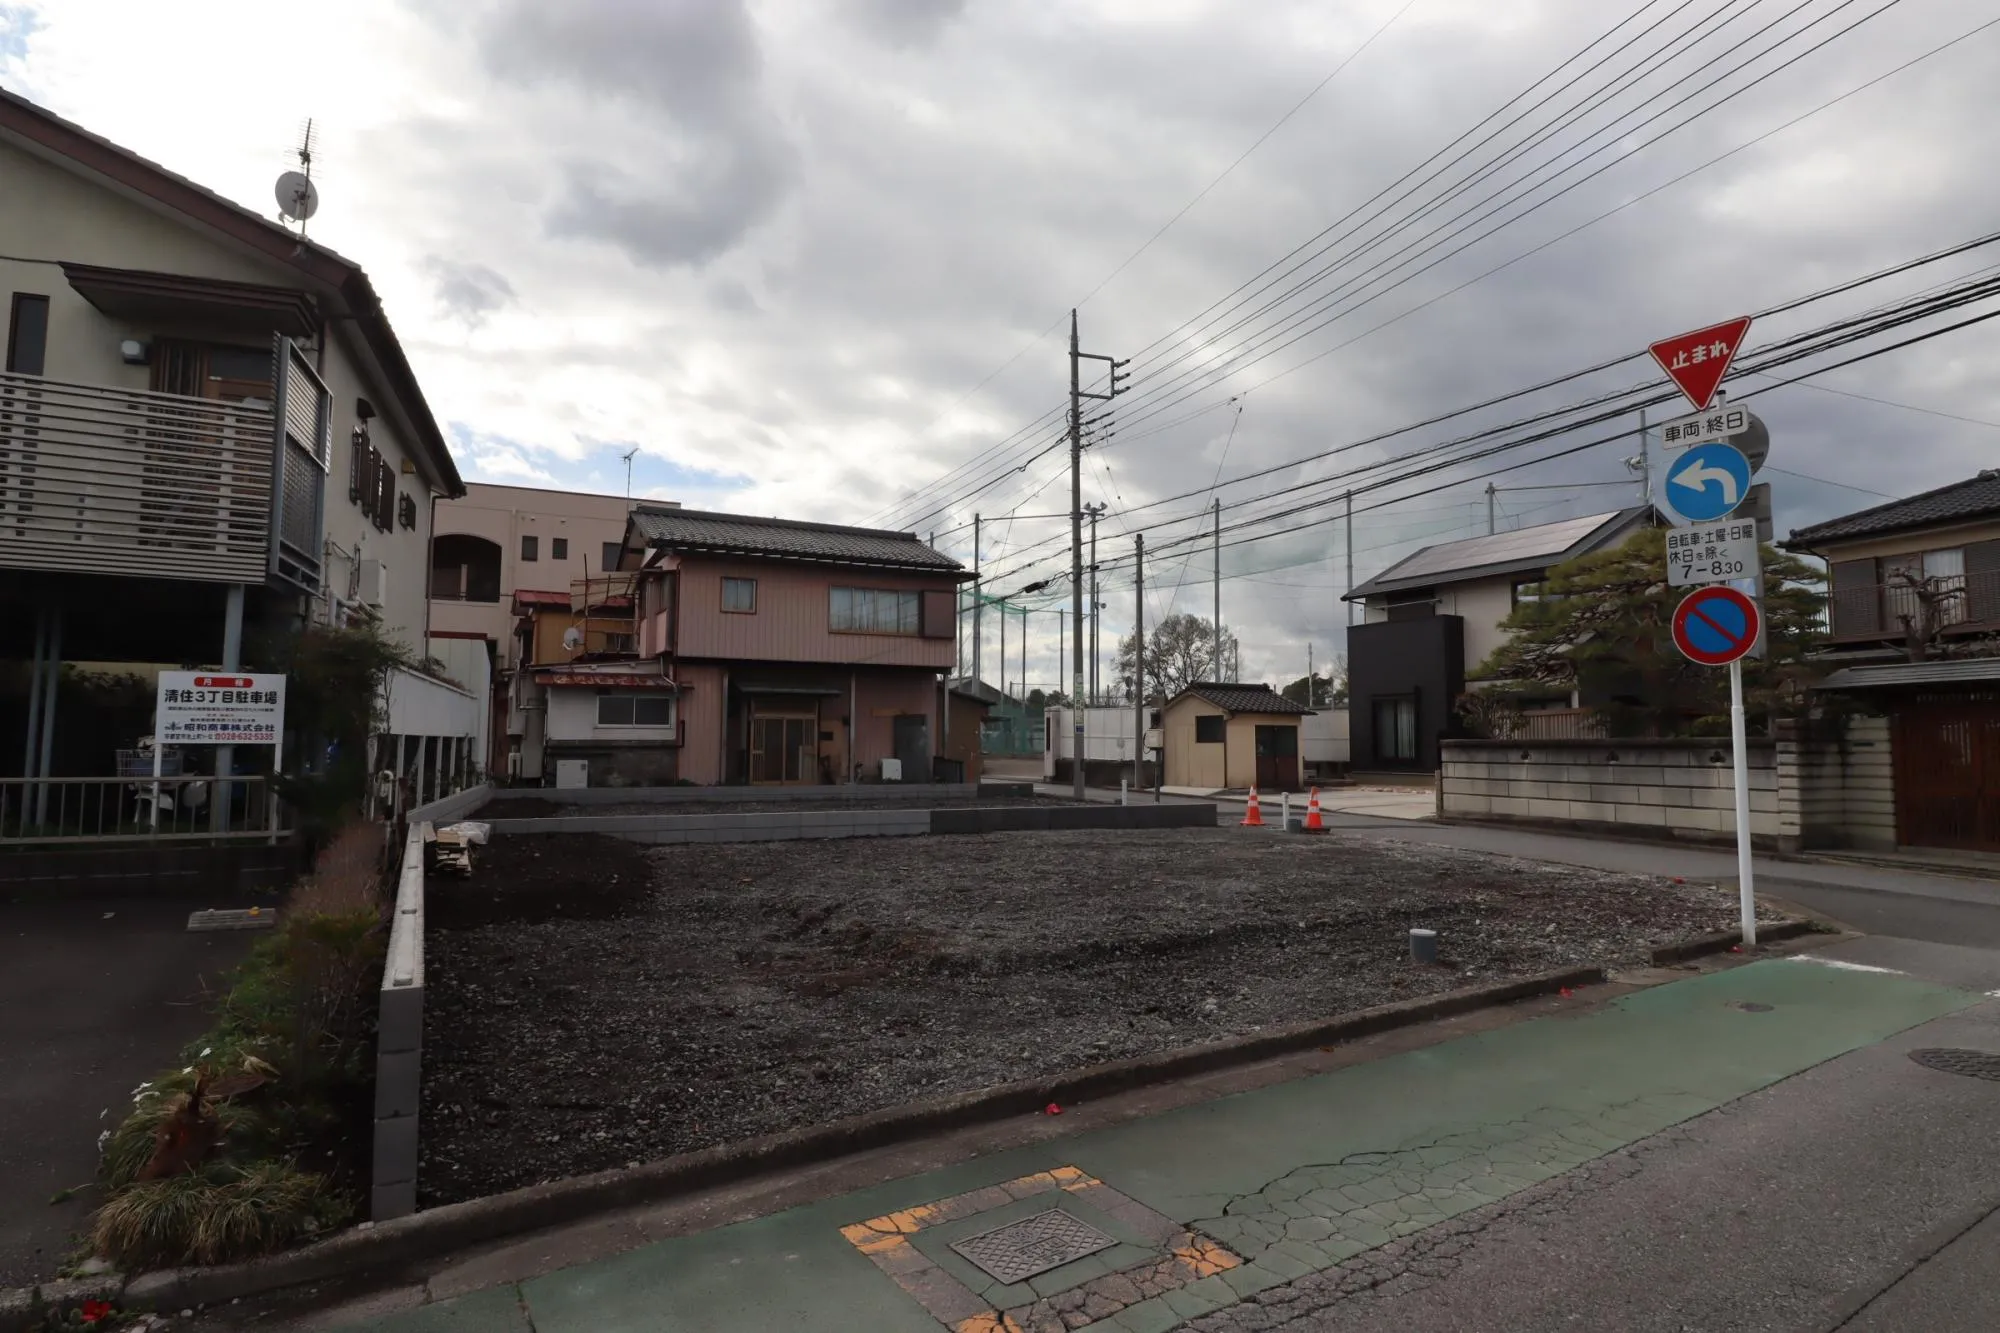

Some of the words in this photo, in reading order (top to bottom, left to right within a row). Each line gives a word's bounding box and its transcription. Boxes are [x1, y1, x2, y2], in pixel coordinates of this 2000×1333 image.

[1671, 340, 1730, 370] 止まれ
[1669, 546, 1729, 565] 休日を除く
[164, 689, 277, 704] 清住3丁目駐車場
